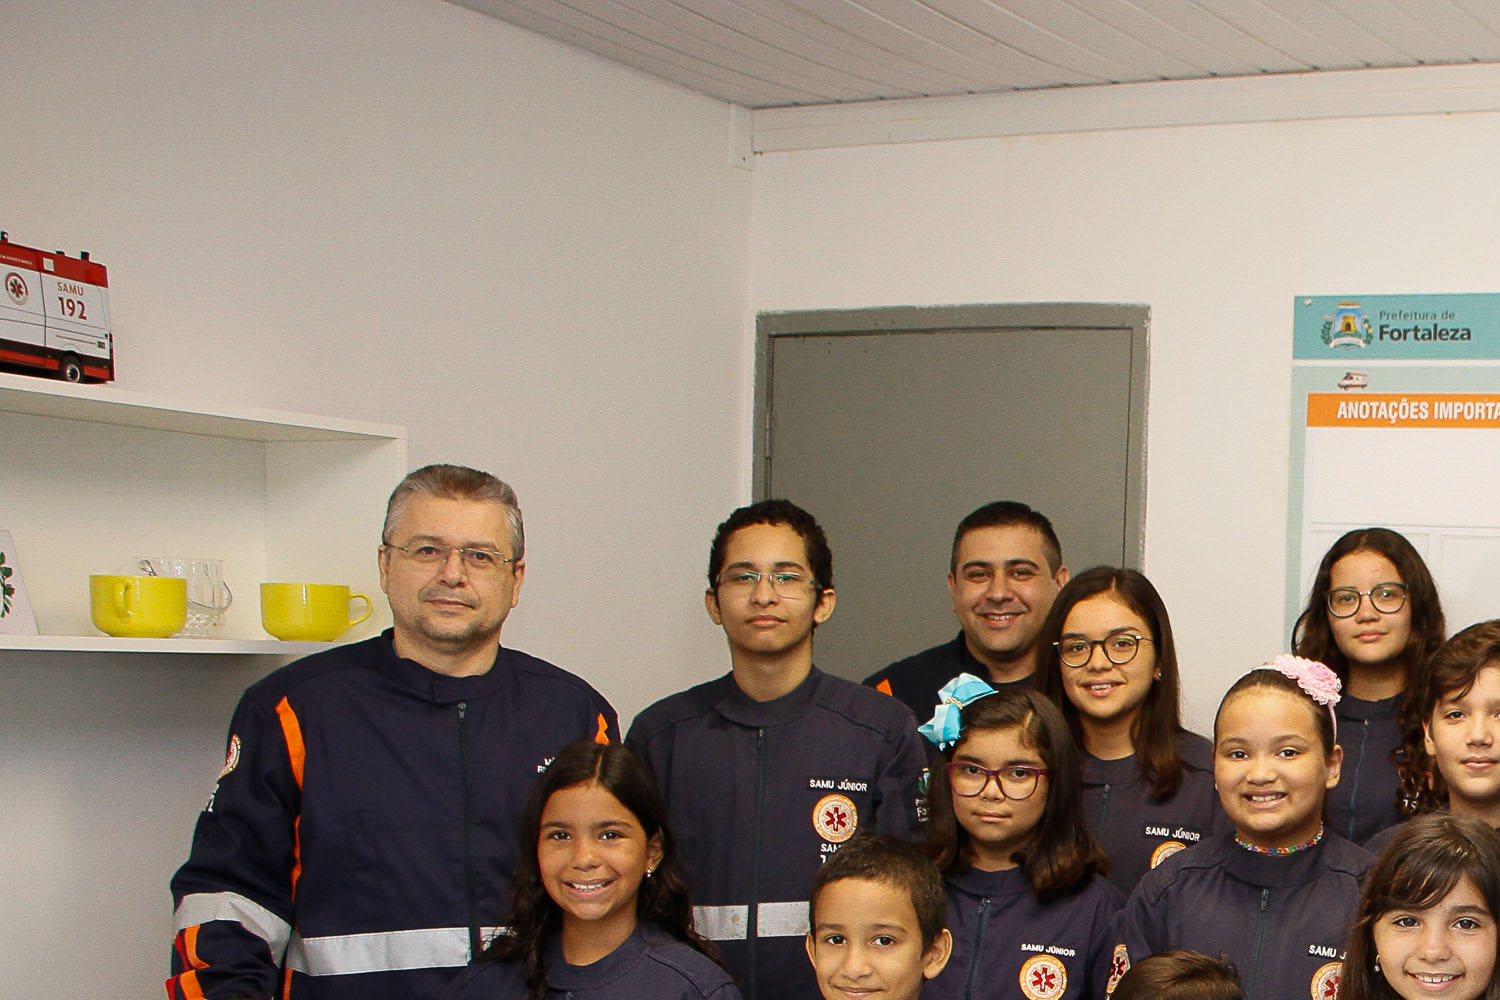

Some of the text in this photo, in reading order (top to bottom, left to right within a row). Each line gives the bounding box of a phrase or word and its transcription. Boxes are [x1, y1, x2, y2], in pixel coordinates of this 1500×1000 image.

[57, 282, 84, 296] SAMU
[58, 297, 87, 320] 192
[1379, 310, 1455, 320] Prefeitura de
[1378, 324, 1471, 341] Fortaleza
[1337, 398, 1429, 424] ANOTAÇÕES
[809, 778, 868, 792] SAMU JÚNIOR
[1145, 826, 1200, 842] SAMU JÚNIOR
[820, 843, 842, 853] SAM
[1021, 943, 1076, 957] SAMU JÚNIOR
[1308, 944, 1337, 958] SAMU
